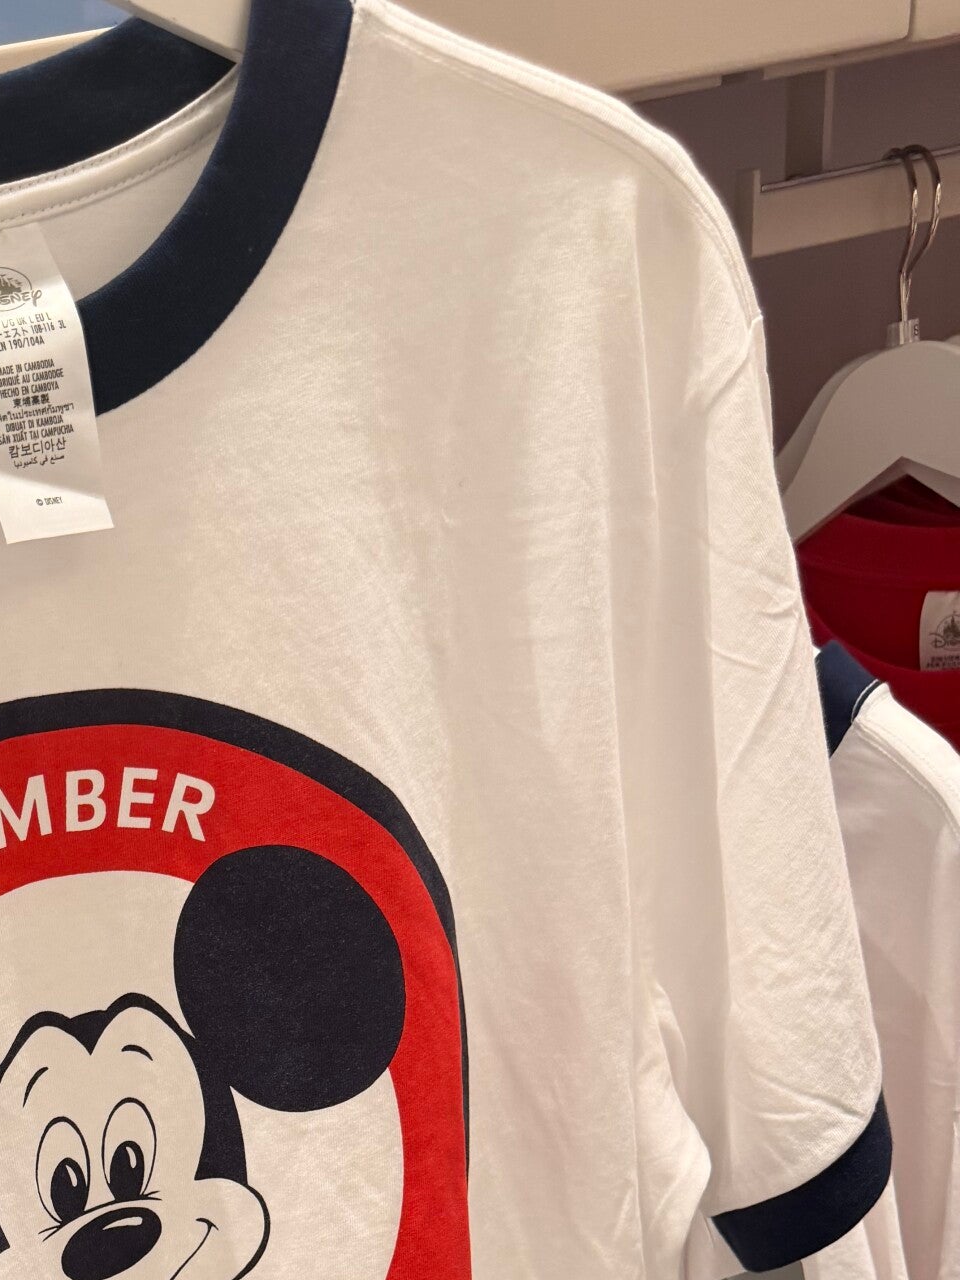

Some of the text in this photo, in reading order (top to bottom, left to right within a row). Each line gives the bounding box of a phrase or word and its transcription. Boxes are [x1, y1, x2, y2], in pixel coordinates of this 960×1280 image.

[2, 318, 16, 328] L/G
[16, 317, 28, 326] UK
[28, 315, 35, 324] L
[35, 313, 45, 322] EU
[45, 312, 52, 320] L
[58, 319, 67, 329] 3L
[9, 335, 45, 350] 190/104A
[15, 363, 23, 373] IN
[24, 358, 54, 372] CAMBODIA
[21, 373, 30, 384] AU
[32, 368, 64, 382] CAMBODGE
[0, 380, 59, 399] HECHO EN CAMBOYA
[6, 415, 64, 432] DIBUAT DI KAMBOJA
[41, 424, 74, 438] CAMPUCHIA
[9, 436, 66, 458] 캄보디아산
[44, 496, 63, 505] DISNEY
